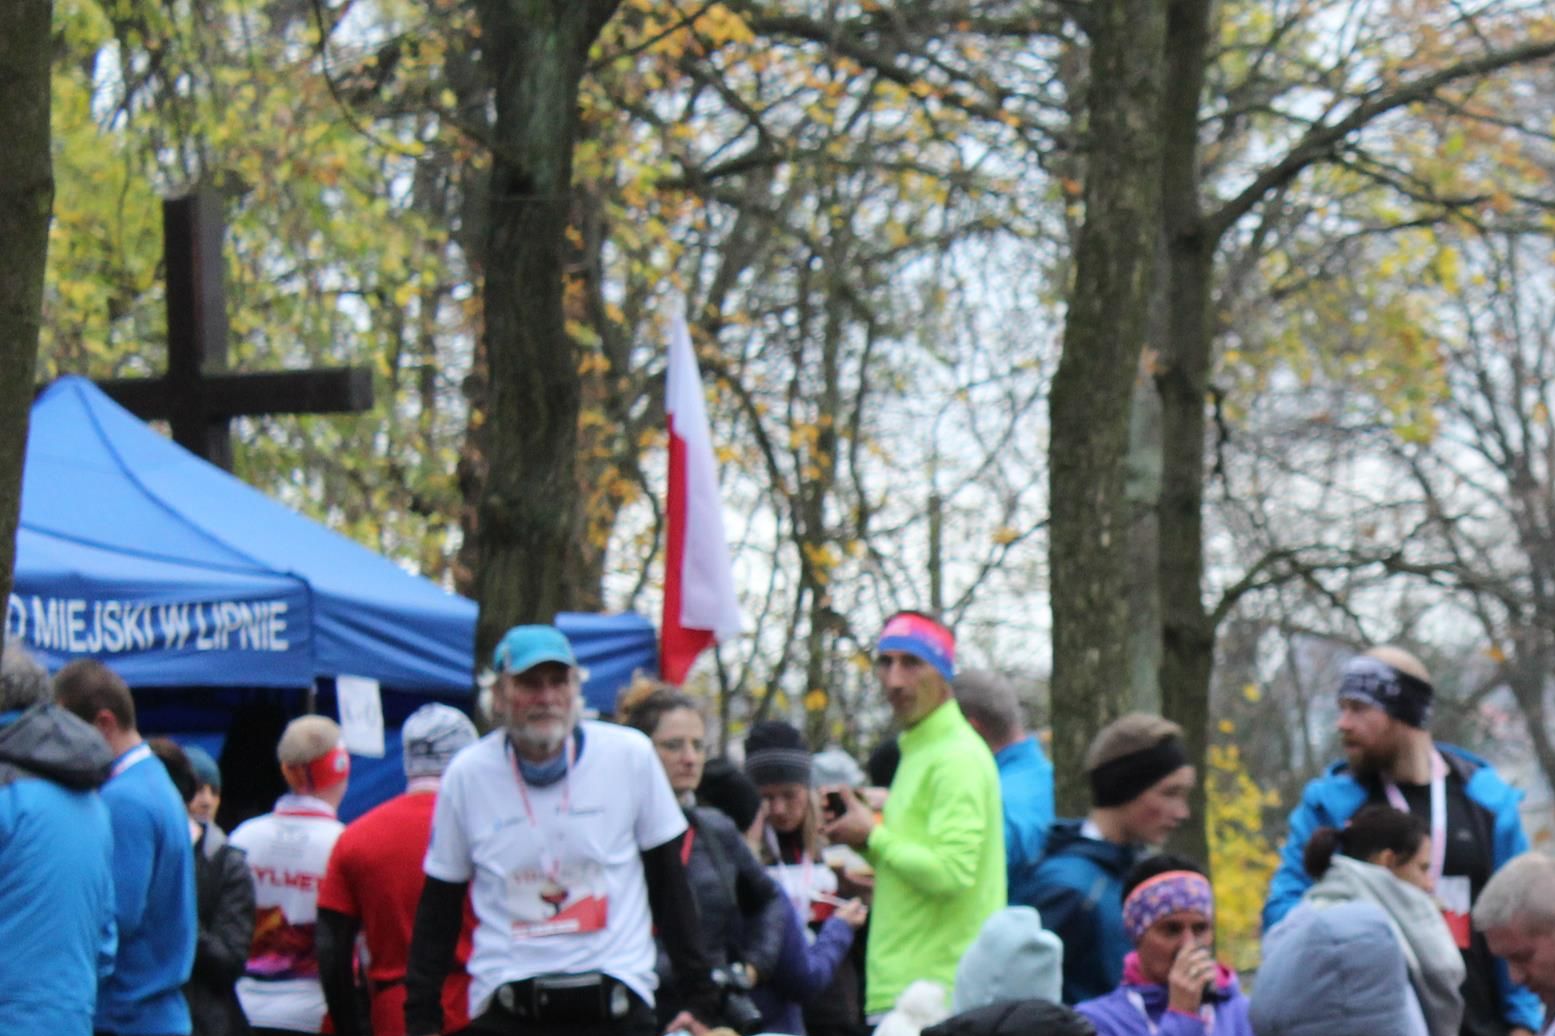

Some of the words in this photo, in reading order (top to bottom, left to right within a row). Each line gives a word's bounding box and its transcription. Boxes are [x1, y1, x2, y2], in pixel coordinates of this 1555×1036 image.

[32, 595, 154, 653] MIEJSKI
[158, 602, 189, 650] W
[195, 602, 289, 651] LIPNIE
